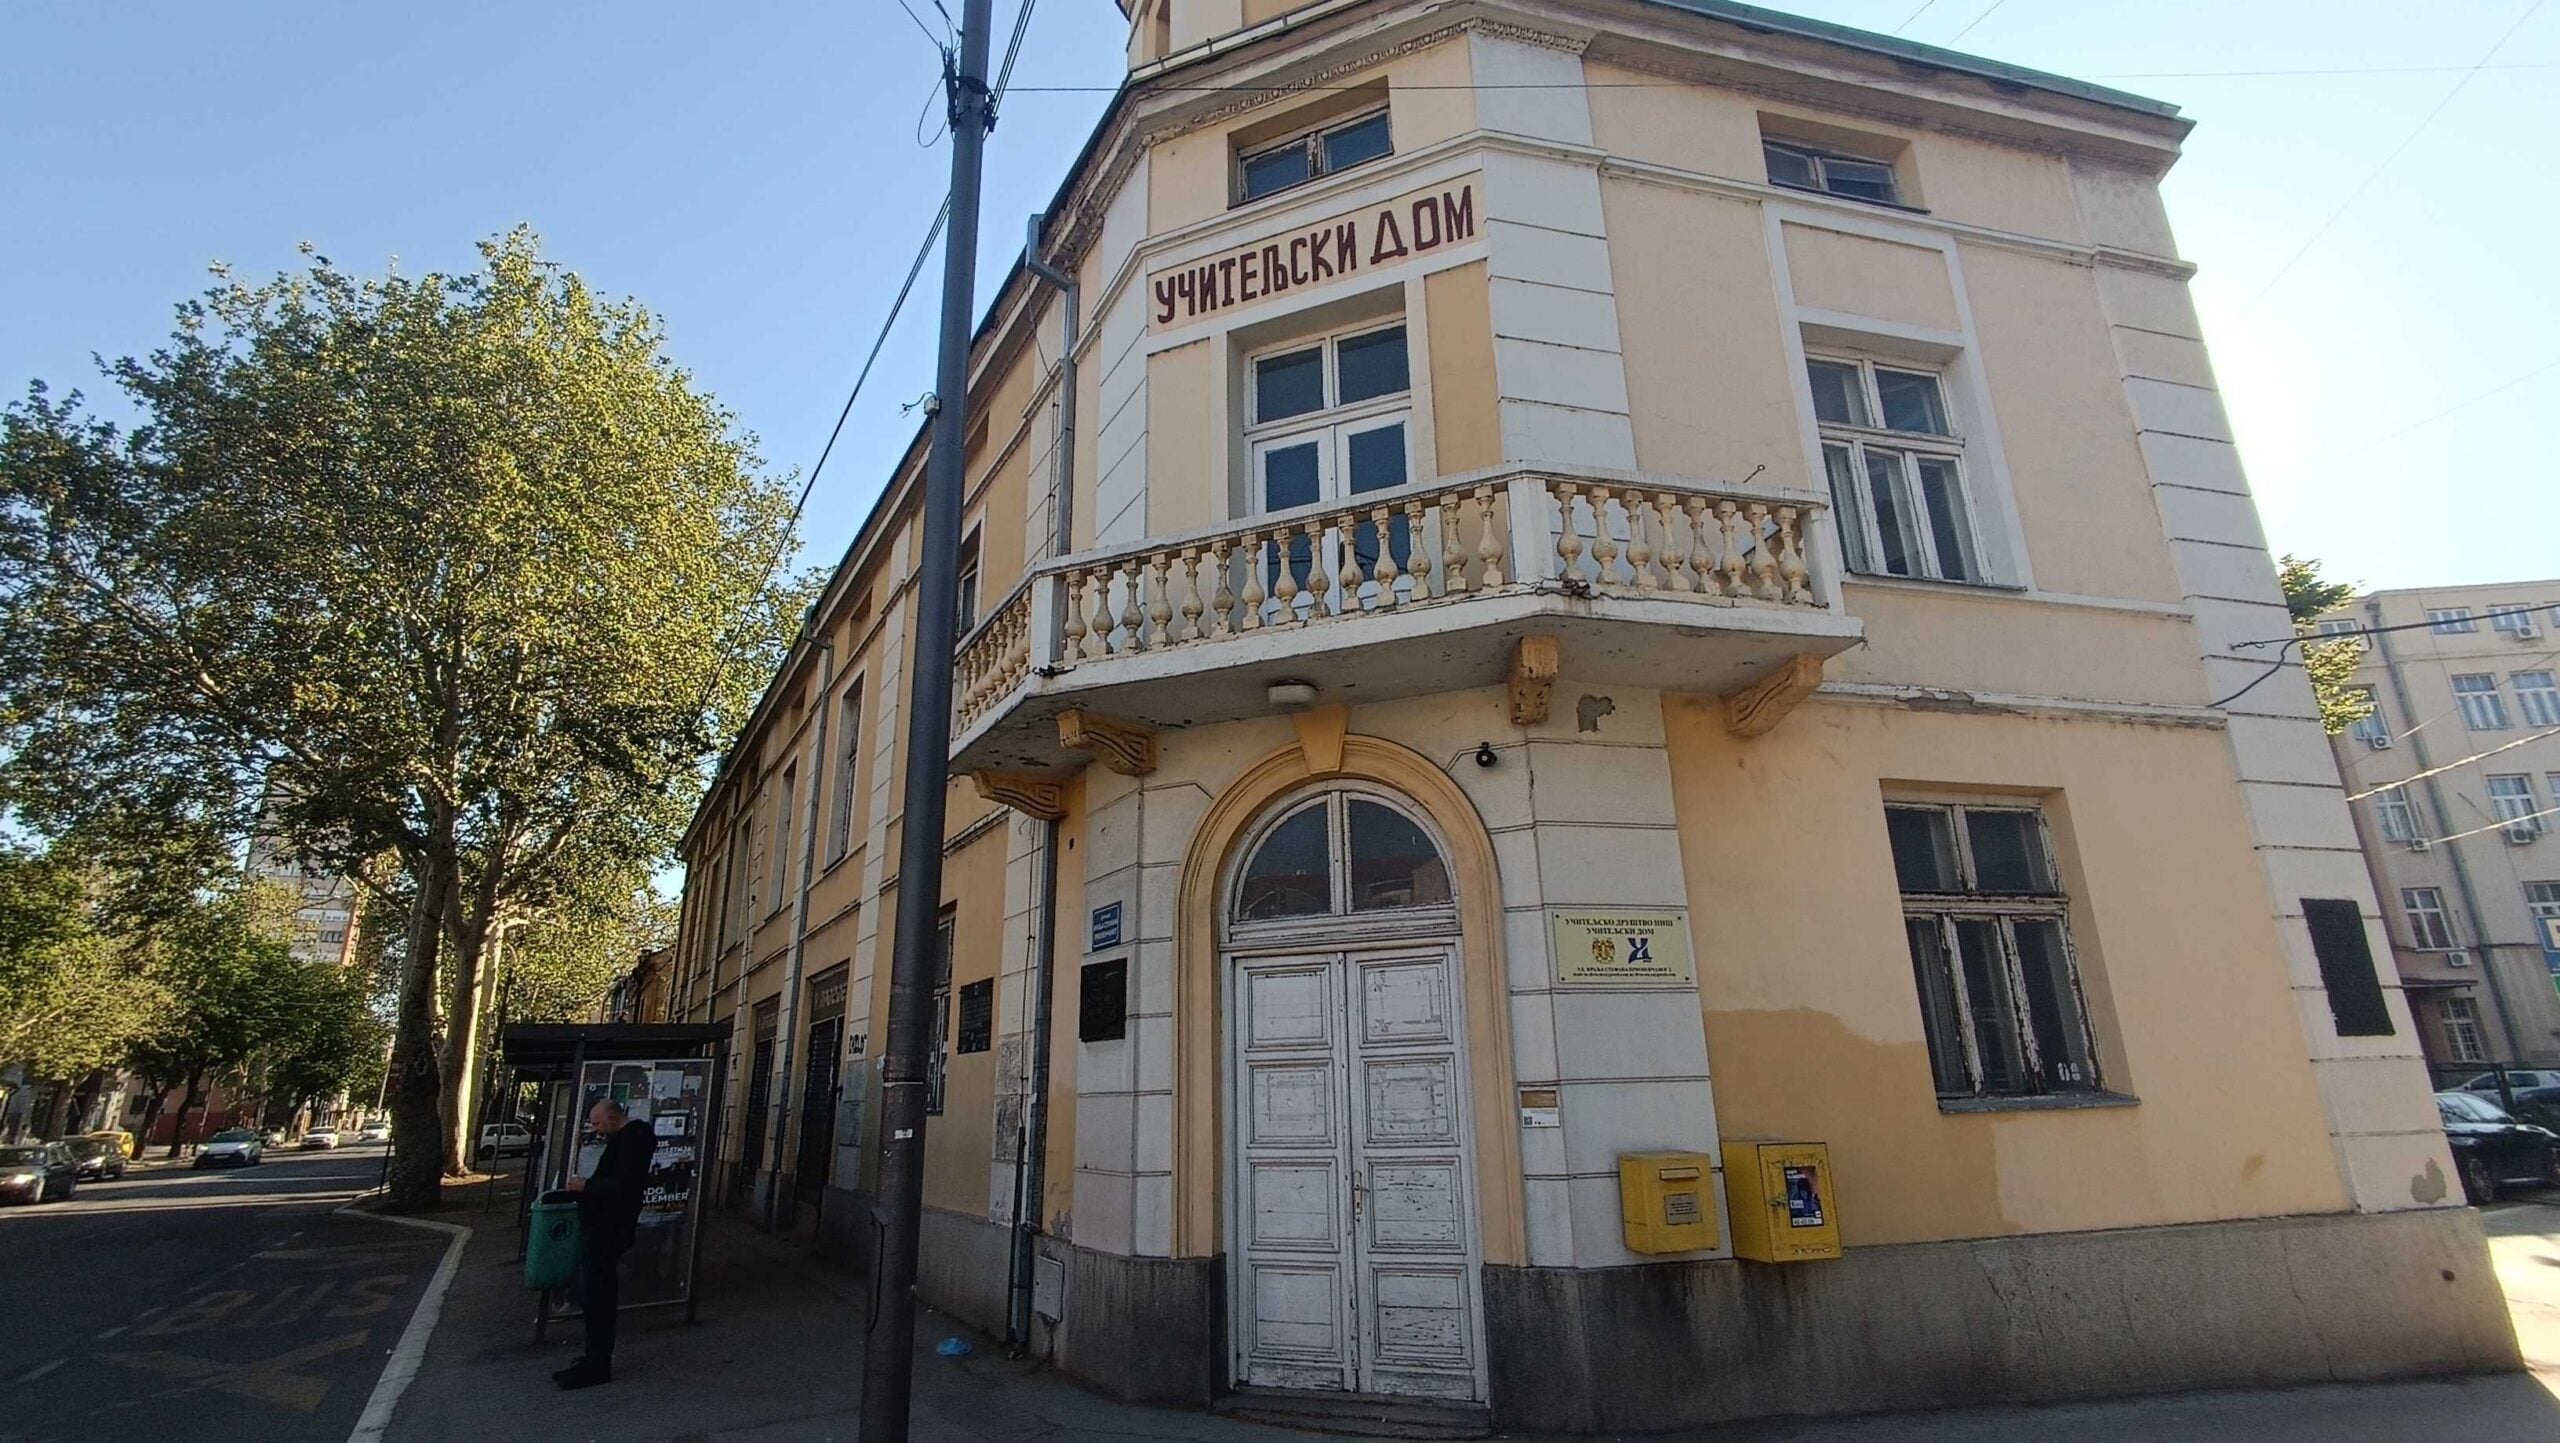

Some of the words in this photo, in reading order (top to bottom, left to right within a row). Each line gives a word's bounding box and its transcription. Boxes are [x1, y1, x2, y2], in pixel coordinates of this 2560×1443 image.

[1155, 221, 1357, 324] УЧИТЕЉСКИ
[1370, 185, 1474, 266] ДОМ
[1565, 918, 1614, 926] УЧИТЕЉСКО
[1615, 919, 1653, 927] ДРУШТВО
[1586, 927, 1635, 935] УЧИТЕЉСКИ
[1636, 927, 1655, 936] ДОМ
